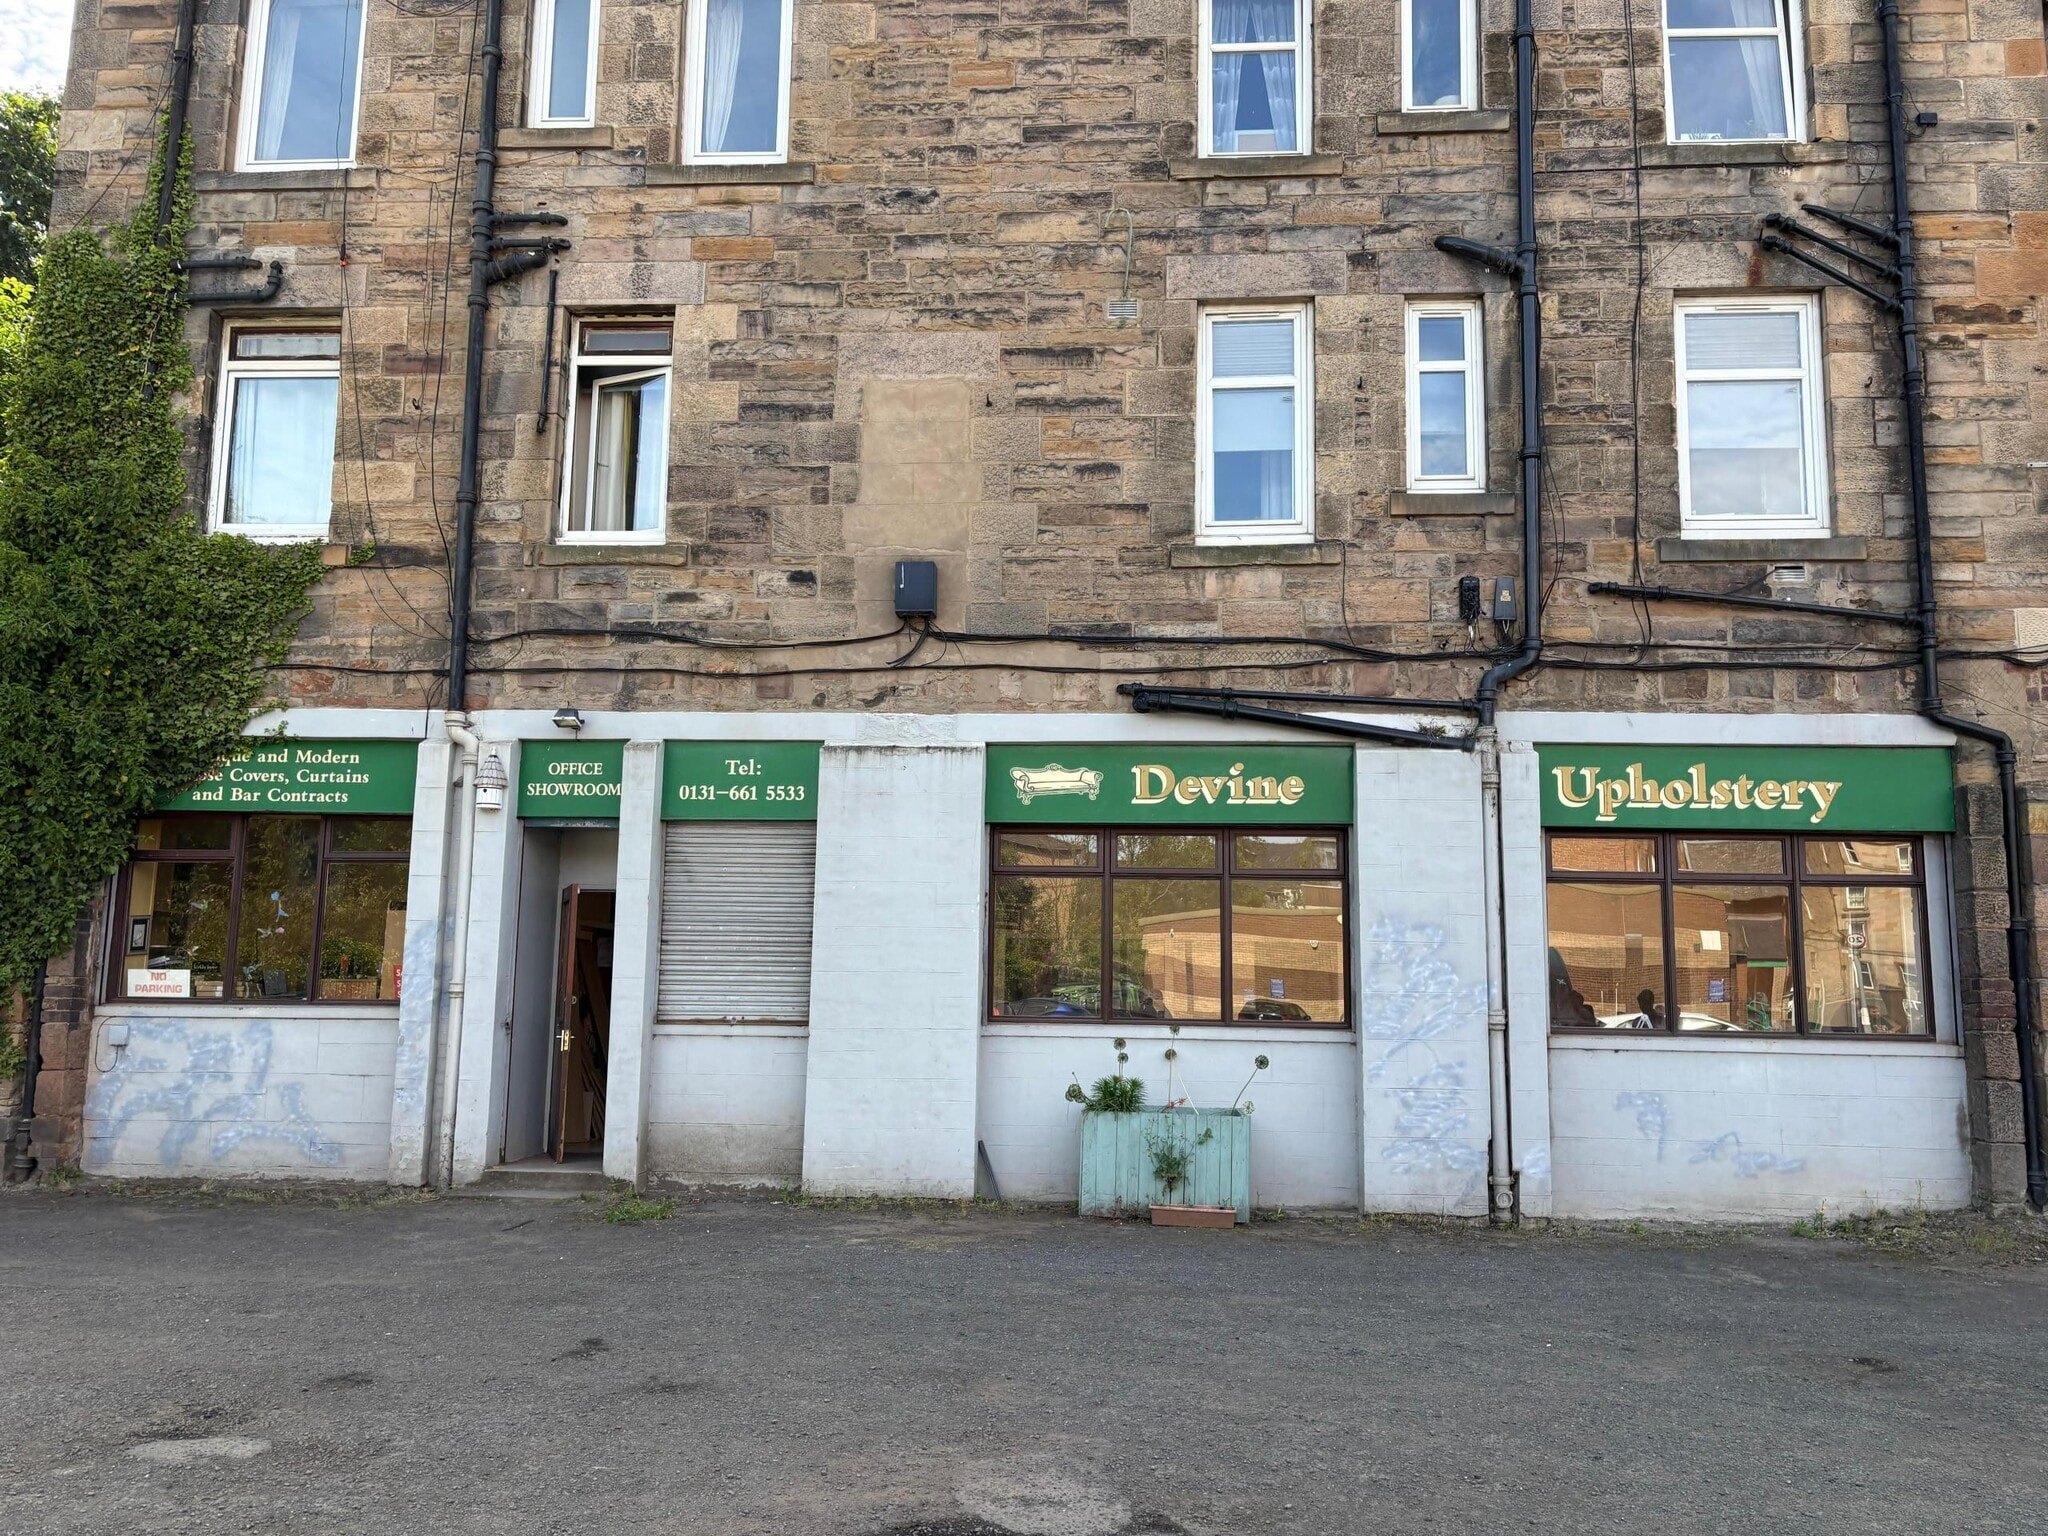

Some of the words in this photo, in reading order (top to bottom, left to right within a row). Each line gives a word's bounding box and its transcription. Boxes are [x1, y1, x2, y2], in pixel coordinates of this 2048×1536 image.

[257, 748, 289, 763] and
[295, 749, 360, 764] Modern
[548, 762, 604, 776] OFFICE
[725, 758, 762, 776] Tel:
[229, 768, 290, 785] Covers,
[296, 769, 370, 784] Curtains
[1130, 762, 1306, 806] Devine
[192, 786, 224, 801] and
[230, 787, 261, 802] Bar
[267, 788, 349, 803] Contracts
[527, 783, 622, 796] SHOWROOM
[765, 785, 805, 801] 5533
[1551, 762, 1843, 824] Upholstery
[150, 972, 167, 981] NO
[134, 983, 183, 993] PARKING
